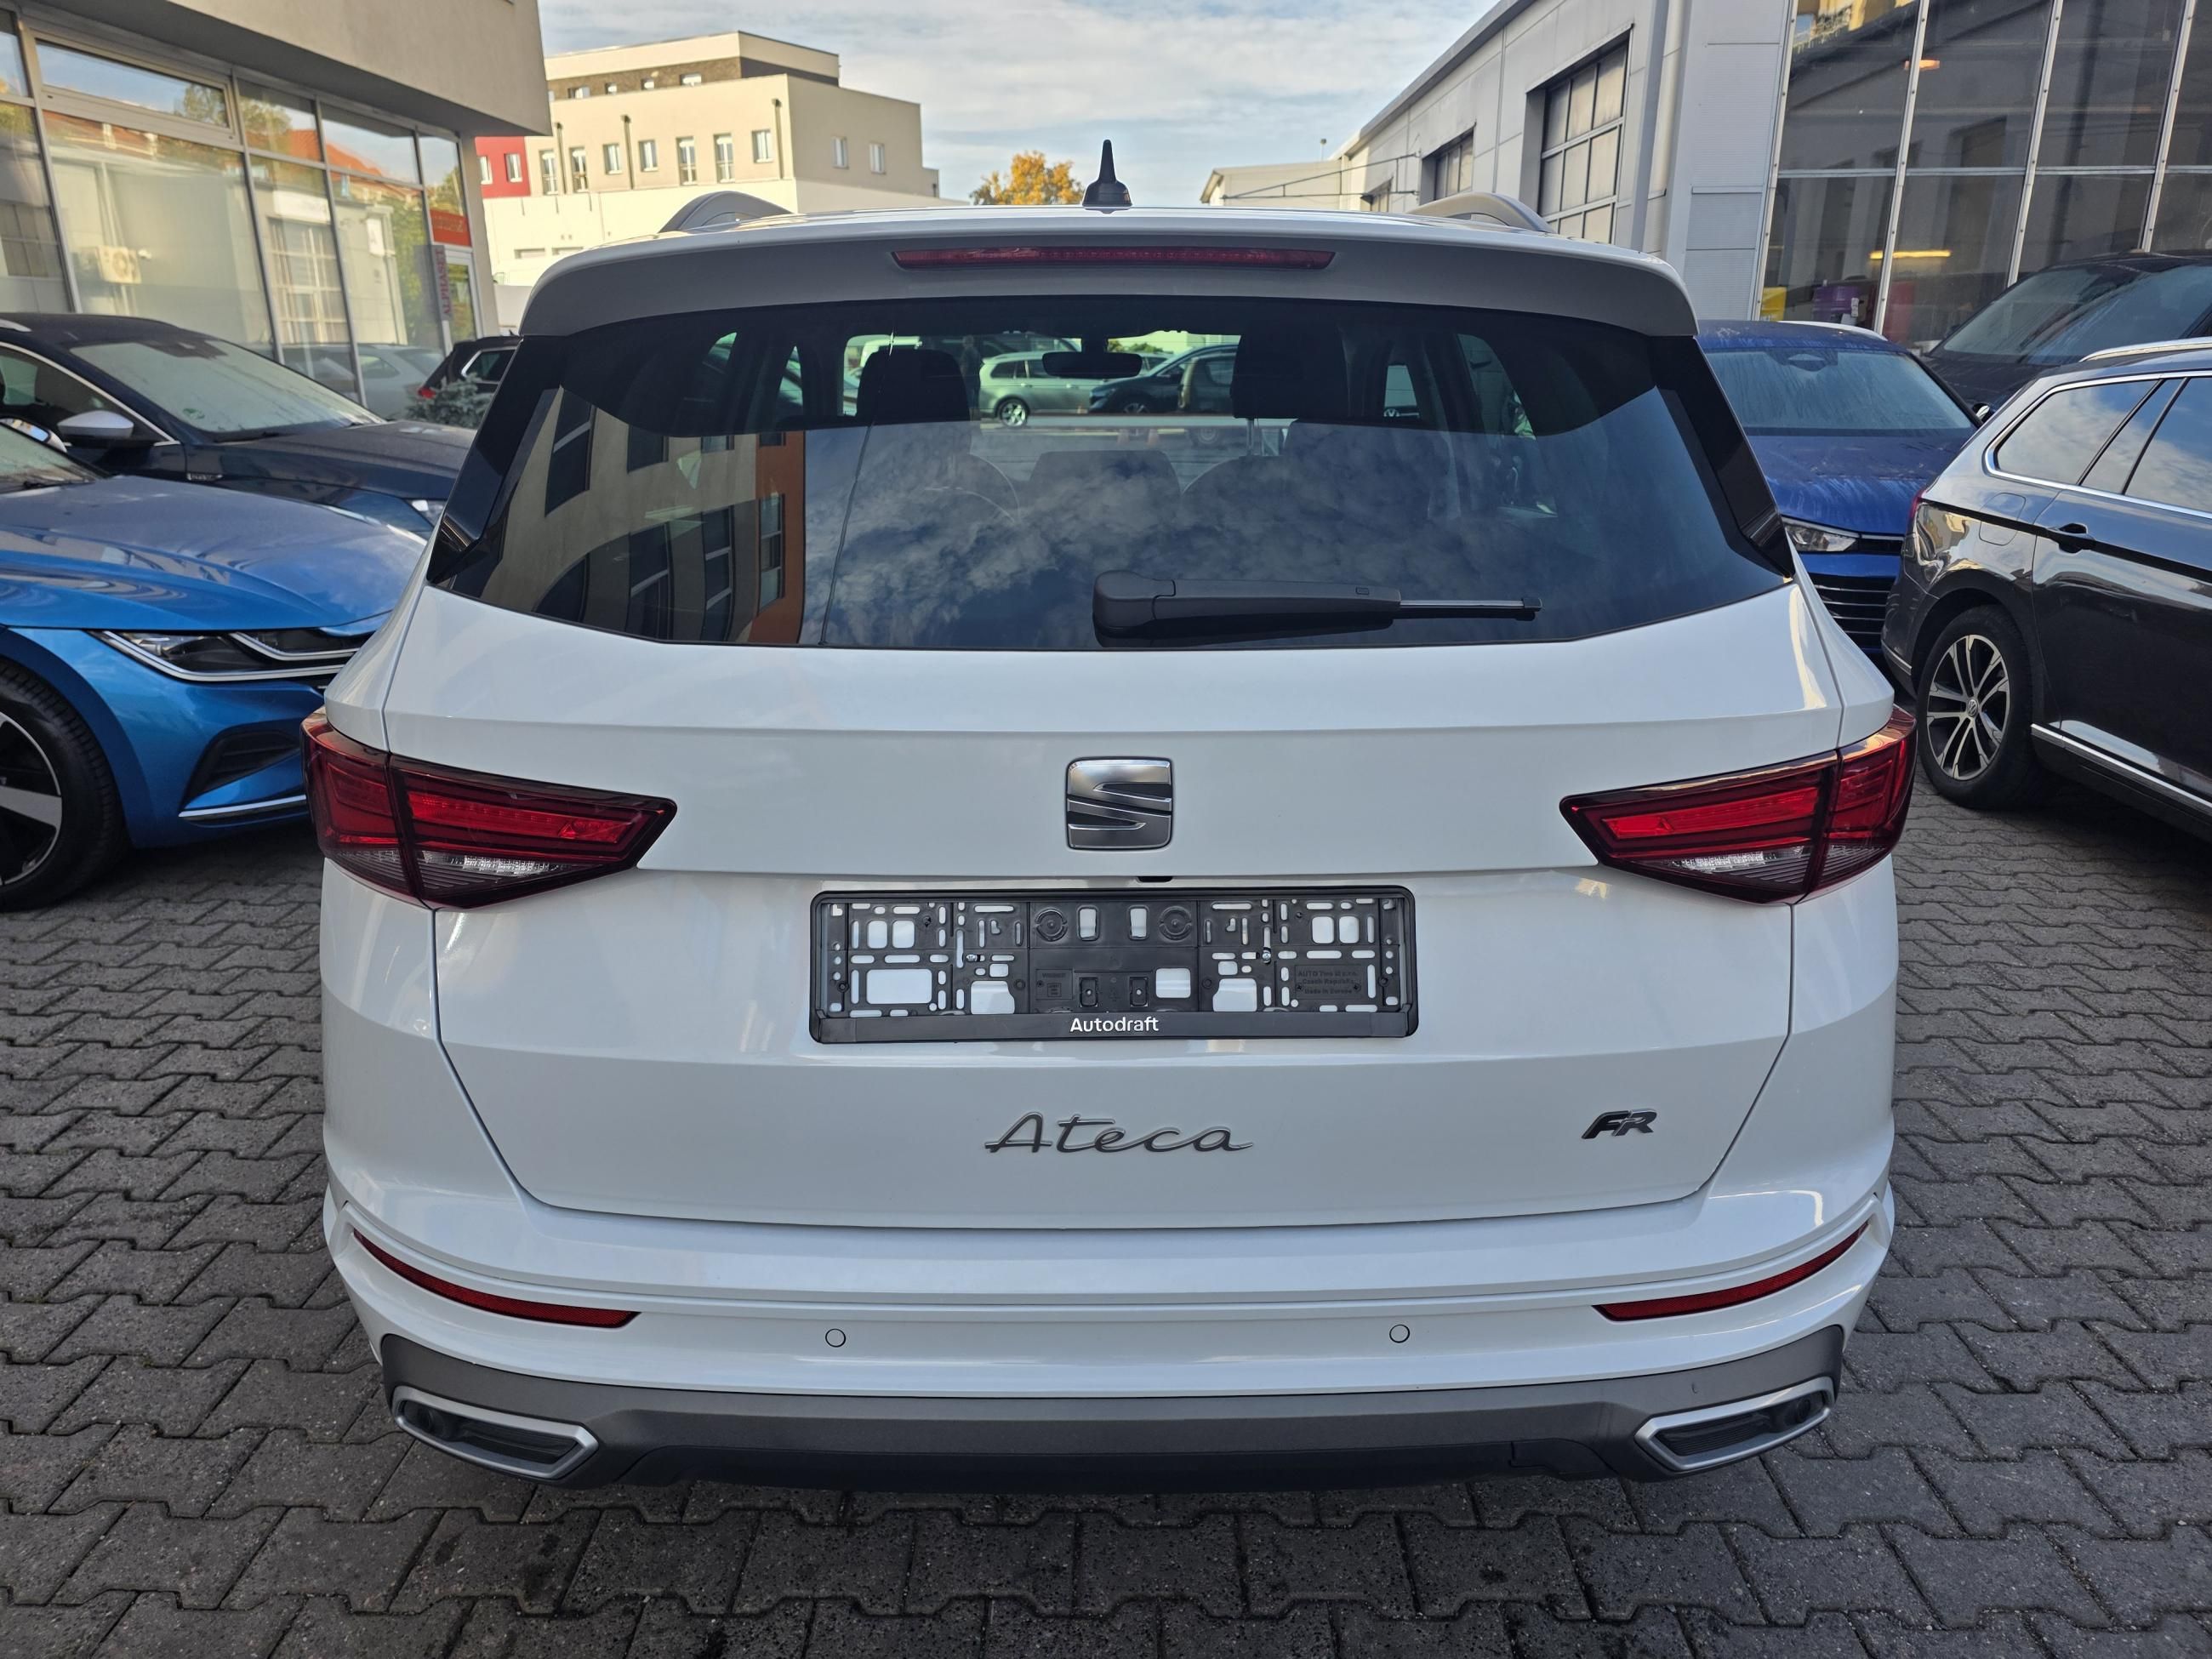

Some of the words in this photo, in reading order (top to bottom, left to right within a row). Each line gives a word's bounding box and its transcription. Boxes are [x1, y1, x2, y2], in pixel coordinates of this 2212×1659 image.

[1070, 1016, 1160, 1033] Autodraft
[984, 1110, 1253, 1154] Ateca
[1580, 1109, 1658, 1140] FR
